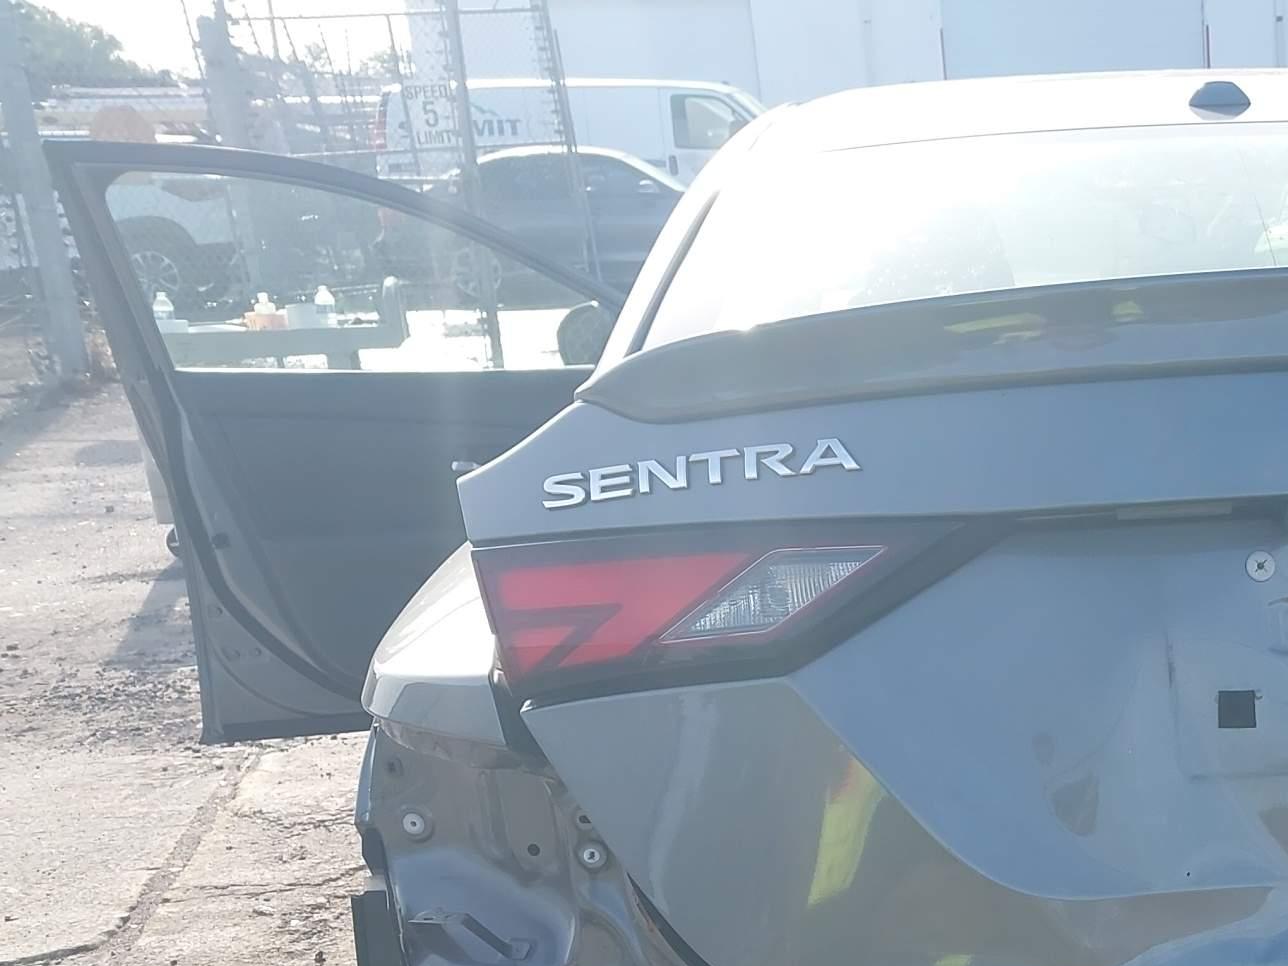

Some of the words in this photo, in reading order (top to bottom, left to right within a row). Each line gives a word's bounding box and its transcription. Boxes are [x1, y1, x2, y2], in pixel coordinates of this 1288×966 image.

[404, 84, 448, 100] SPEED
[422, 101, 438, 128] 5
[416, 129, 452, 145] LIMIT
[542, 437, 861, 510] SENTRA
